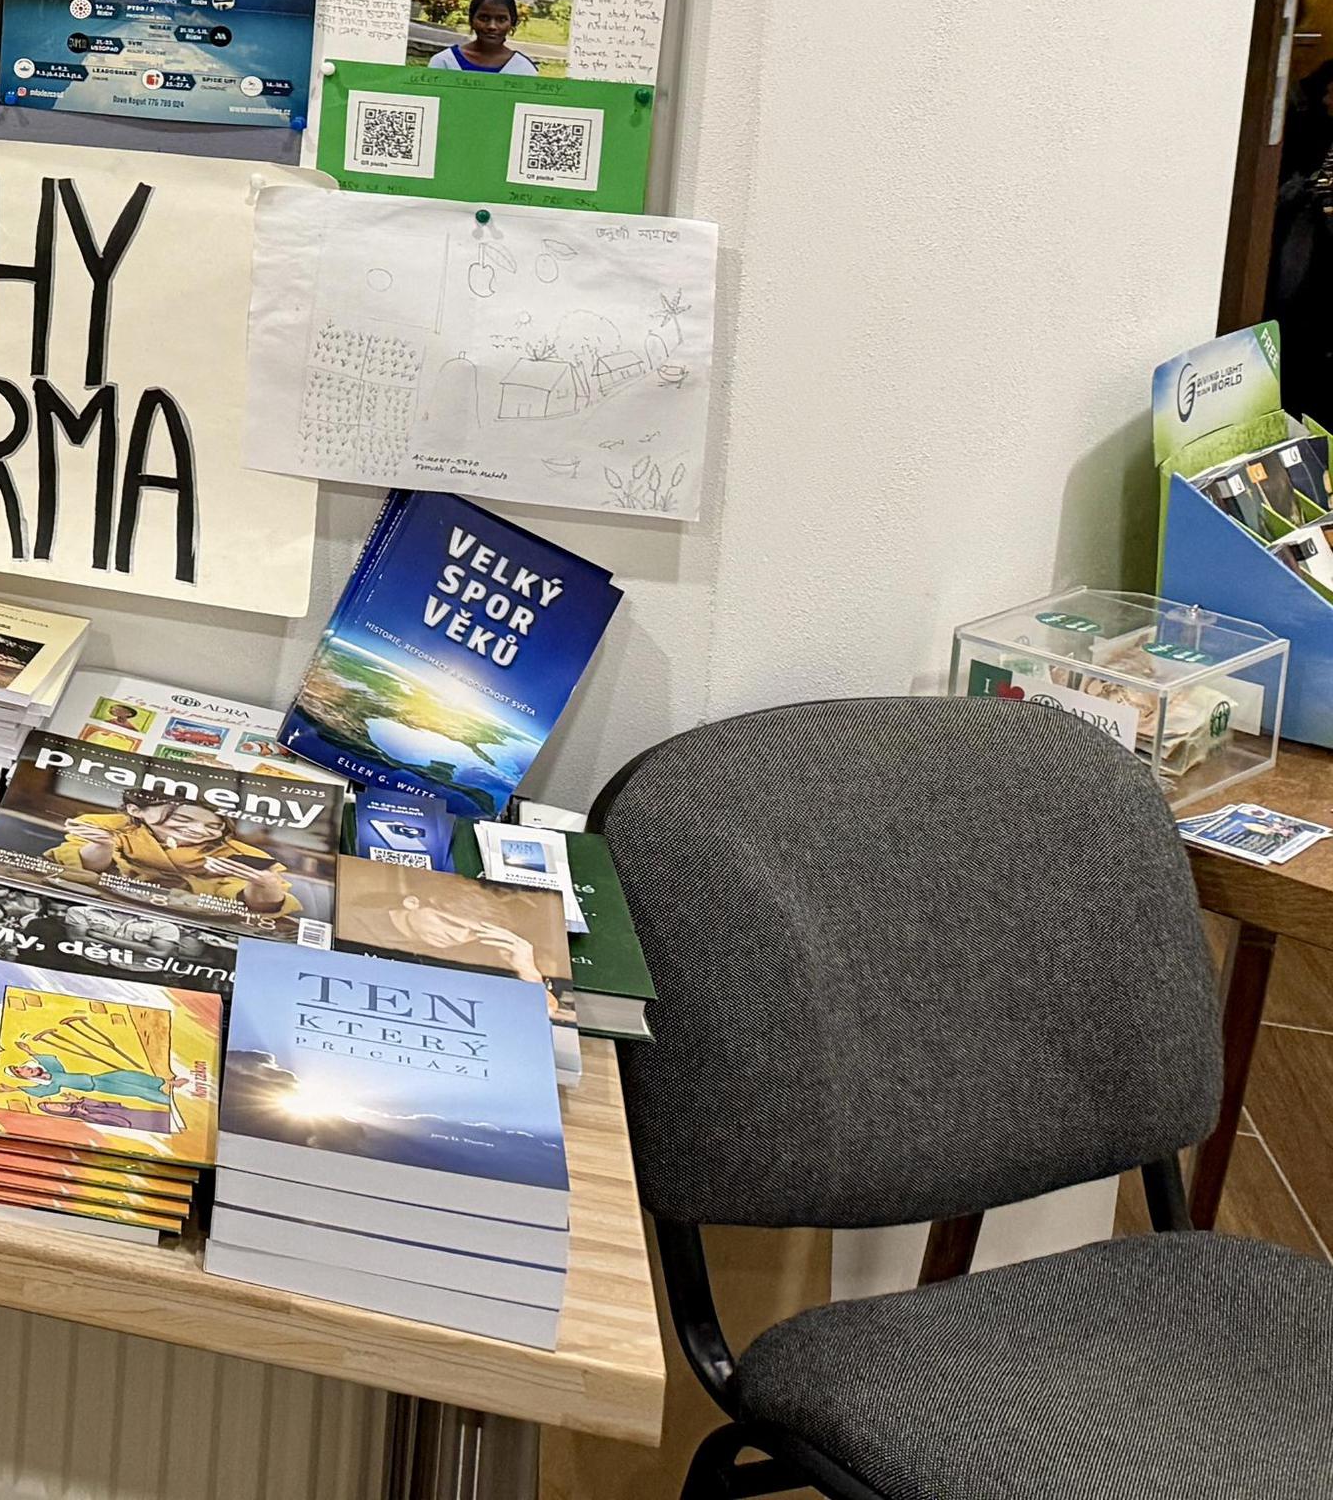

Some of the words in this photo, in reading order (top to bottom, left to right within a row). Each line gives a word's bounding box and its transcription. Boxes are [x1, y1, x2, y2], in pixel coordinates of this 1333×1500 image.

[1260, 327, 1279, 368] FREE
[1220, 363, 1243, 378] LIGHT
[445, 526, 564, 608] VELKÝ
[436, 564, 535, 636] SPOR
[422, 594, 519, 668] VĚKŮ
[206, 703, 250, 720] ADRA
[34, 746, 326, 830] prameny
[280, 786, 326, 798] 2/2025
[337, 756, 374, 778] ELLEN
[378, 773, 391, 785] G.
[396, 782, 437, 799] WHITE
[215, 808, 287, 828] zdraví
[240, 916, 277, 930] 18
[57, 939, 134, 967] děti
[297, 971, 484, 1029] TEN
[297, 1013, 489, 1058] KTERÝ
